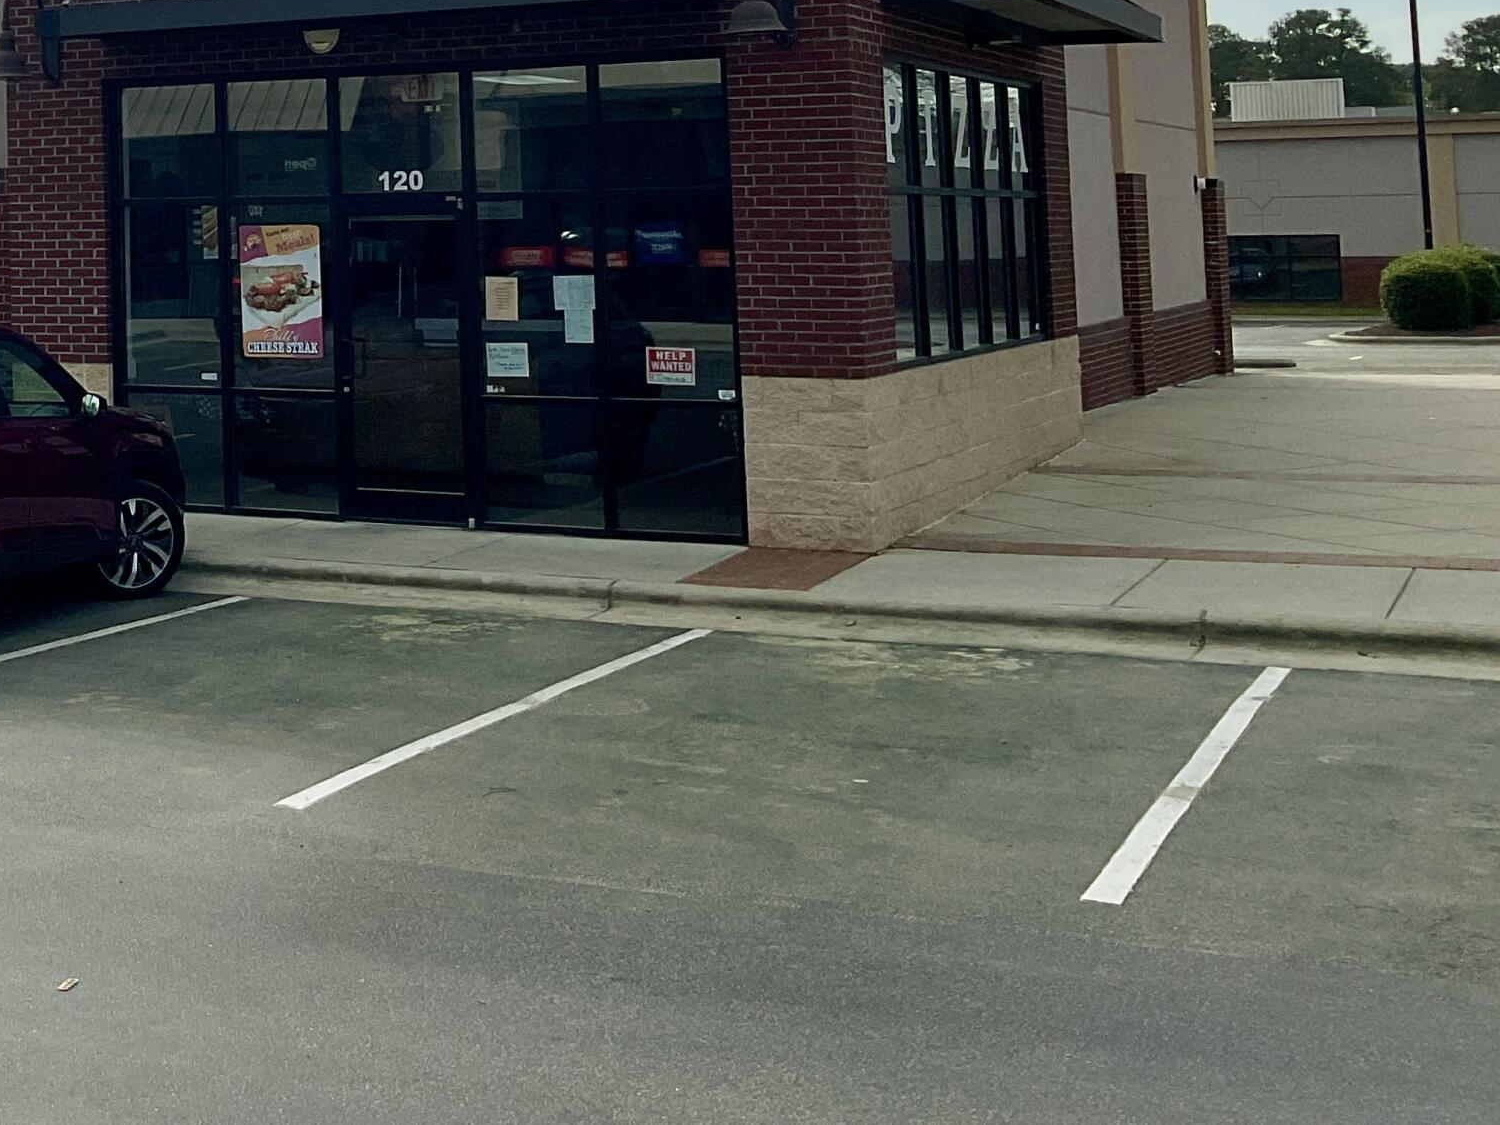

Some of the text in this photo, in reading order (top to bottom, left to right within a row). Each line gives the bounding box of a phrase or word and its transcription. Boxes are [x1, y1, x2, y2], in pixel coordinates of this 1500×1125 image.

[883, 89, 1029, 173] PIZZA
[378, 170, 424, 191] 120
[247, 342, 318, 354] CHEESE STEAK
[655, 351, 687, 361] HELP
[650, 360, 692, 372] WANTED
